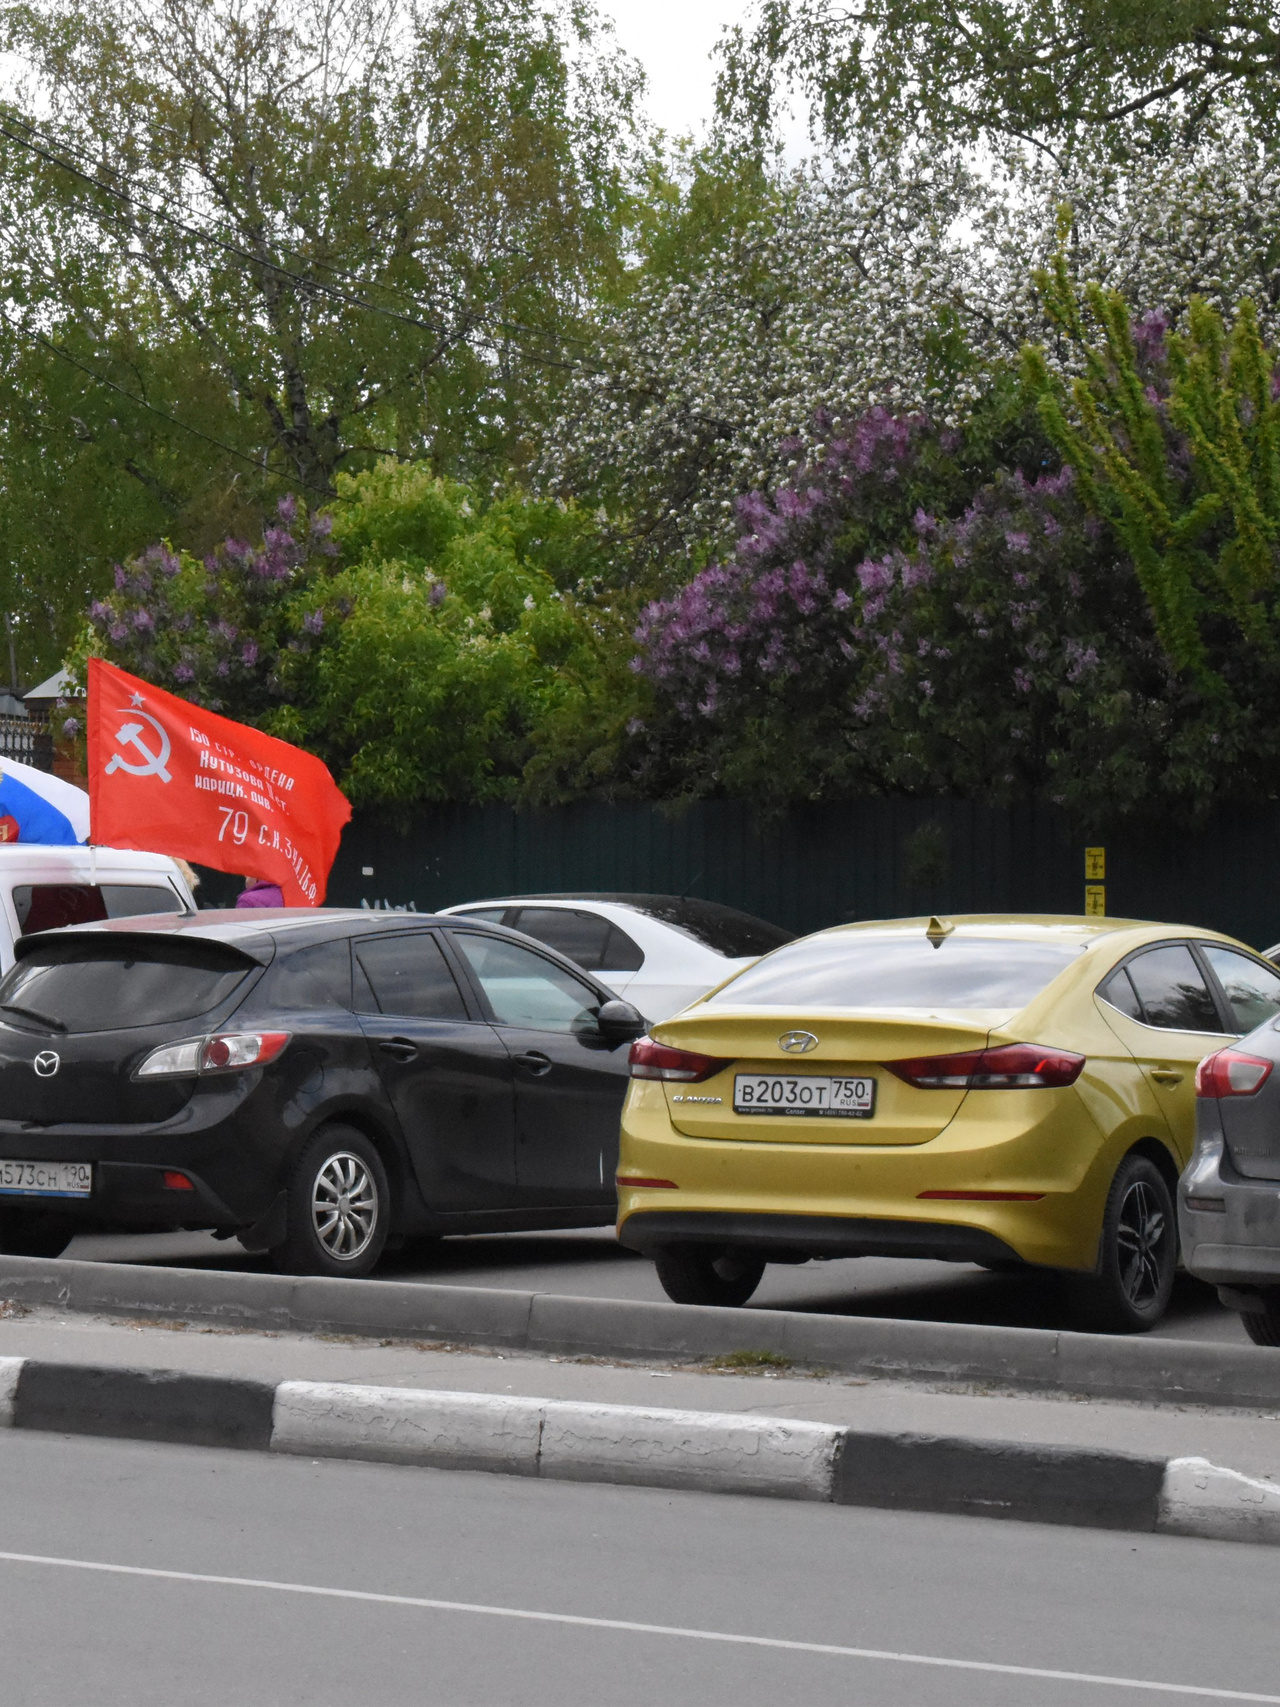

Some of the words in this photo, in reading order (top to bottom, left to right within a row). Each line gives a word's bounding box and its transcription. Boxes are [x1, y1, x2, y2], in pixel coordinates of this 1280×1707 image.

[189, 726, 211, 747] 150
[218, 805, 249, 845] 79
[832, 1080, 866, 1099] 750
[839, 1099, 858, 1107] RUS
[66, 1181, 80, 1189] RUS
